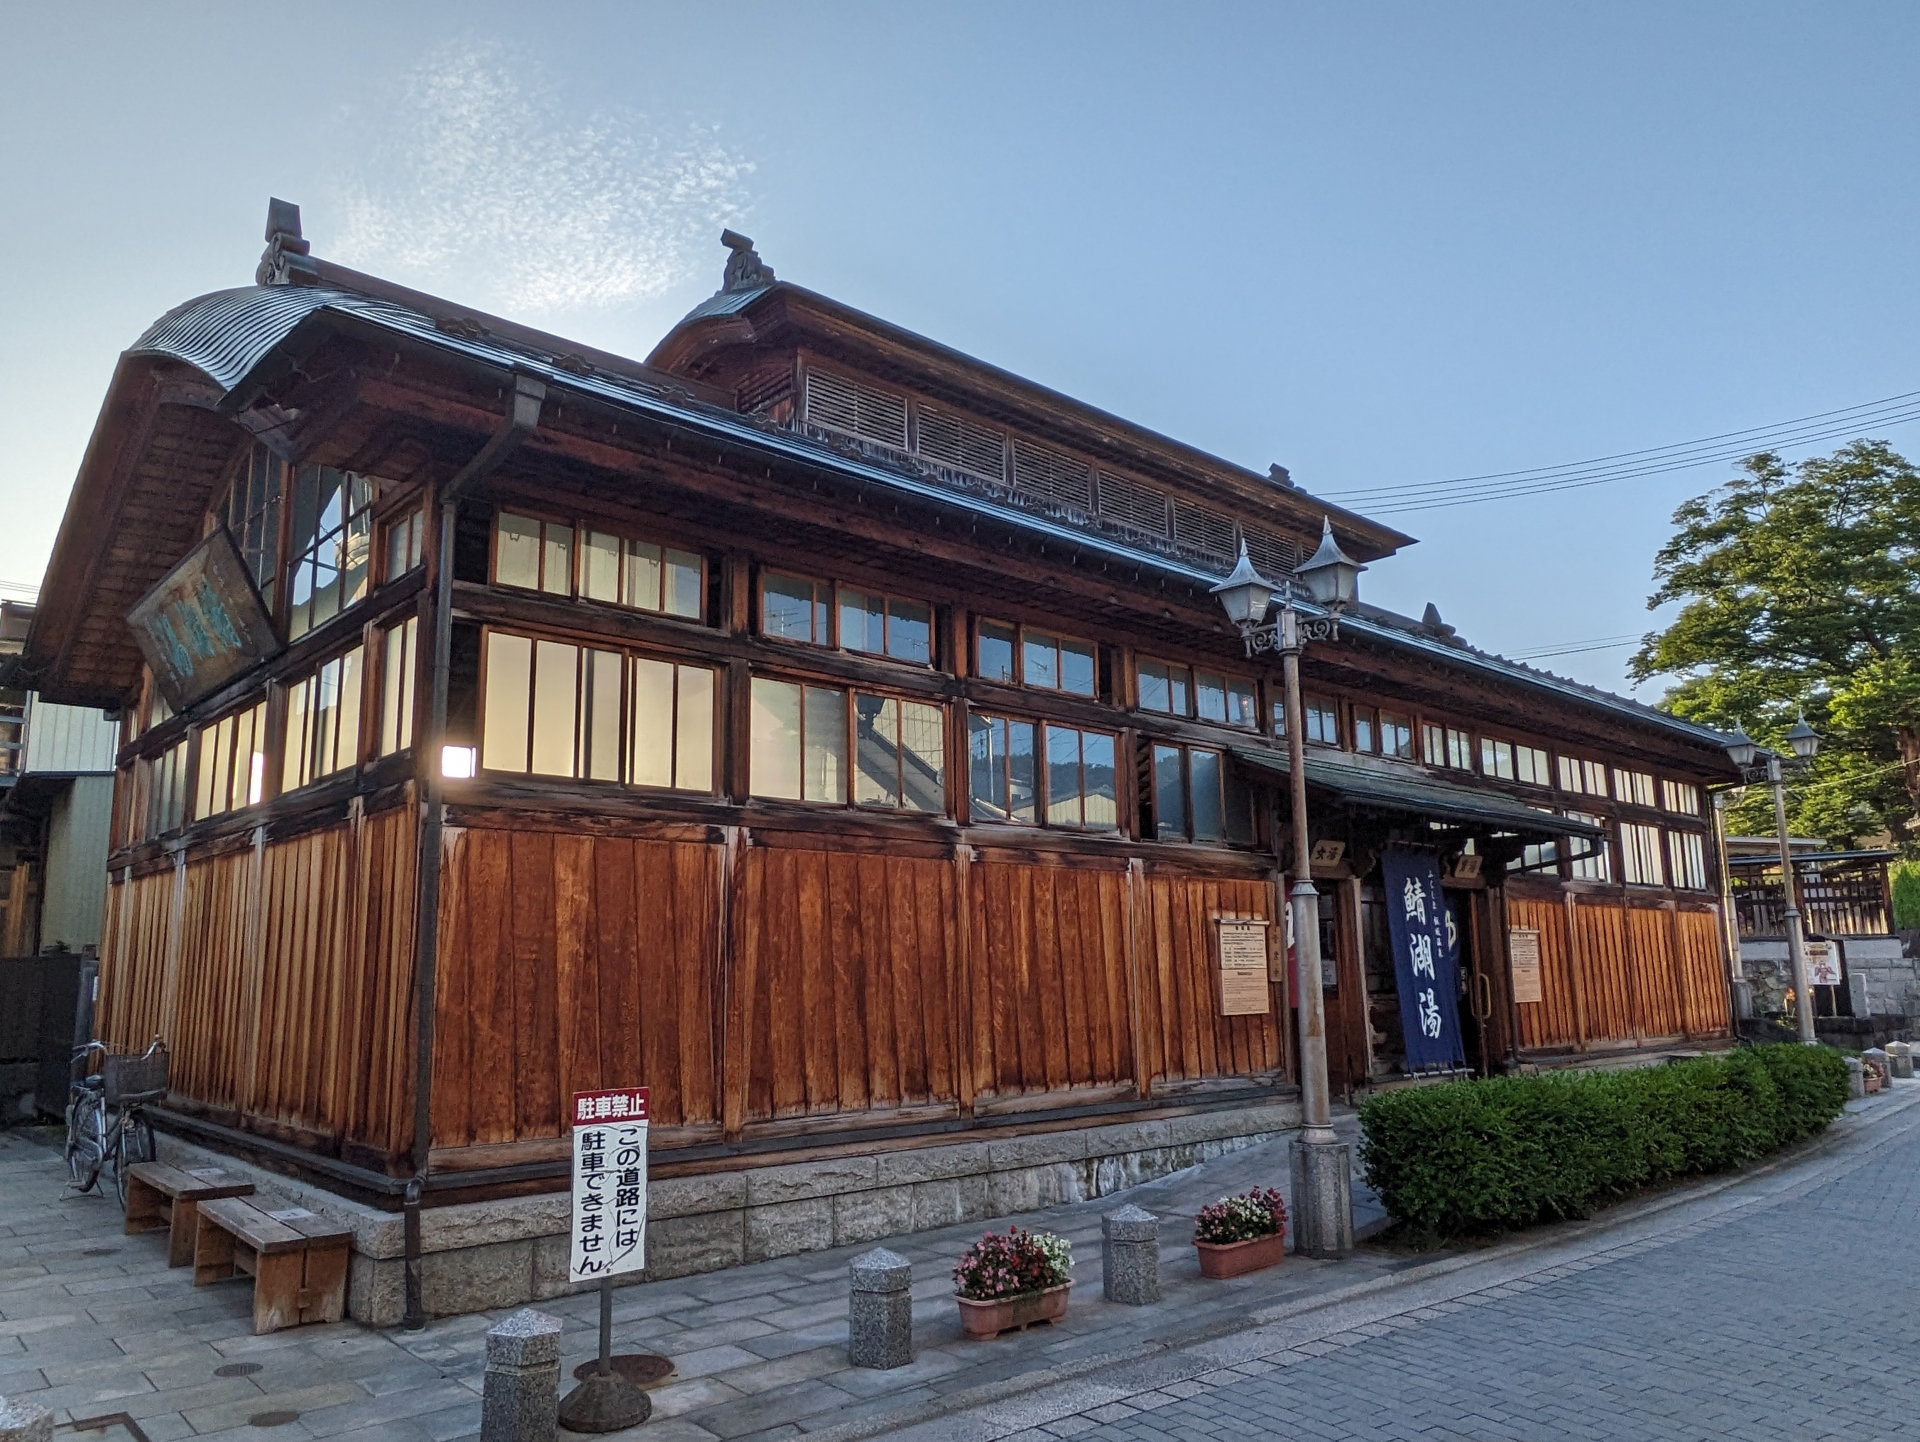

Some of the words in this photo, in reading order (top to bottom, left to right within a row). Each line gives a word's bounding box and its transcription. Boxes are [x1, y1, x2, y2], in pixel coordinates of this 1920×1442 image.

[1404, 876, 1442, 1039] 鯖湖湯
[577, 1093, 645, 1120] 駐車禁止
[579, 1130, 606, 1275] 駐車できません
[615, 1128, 640, 1248] この道路には
